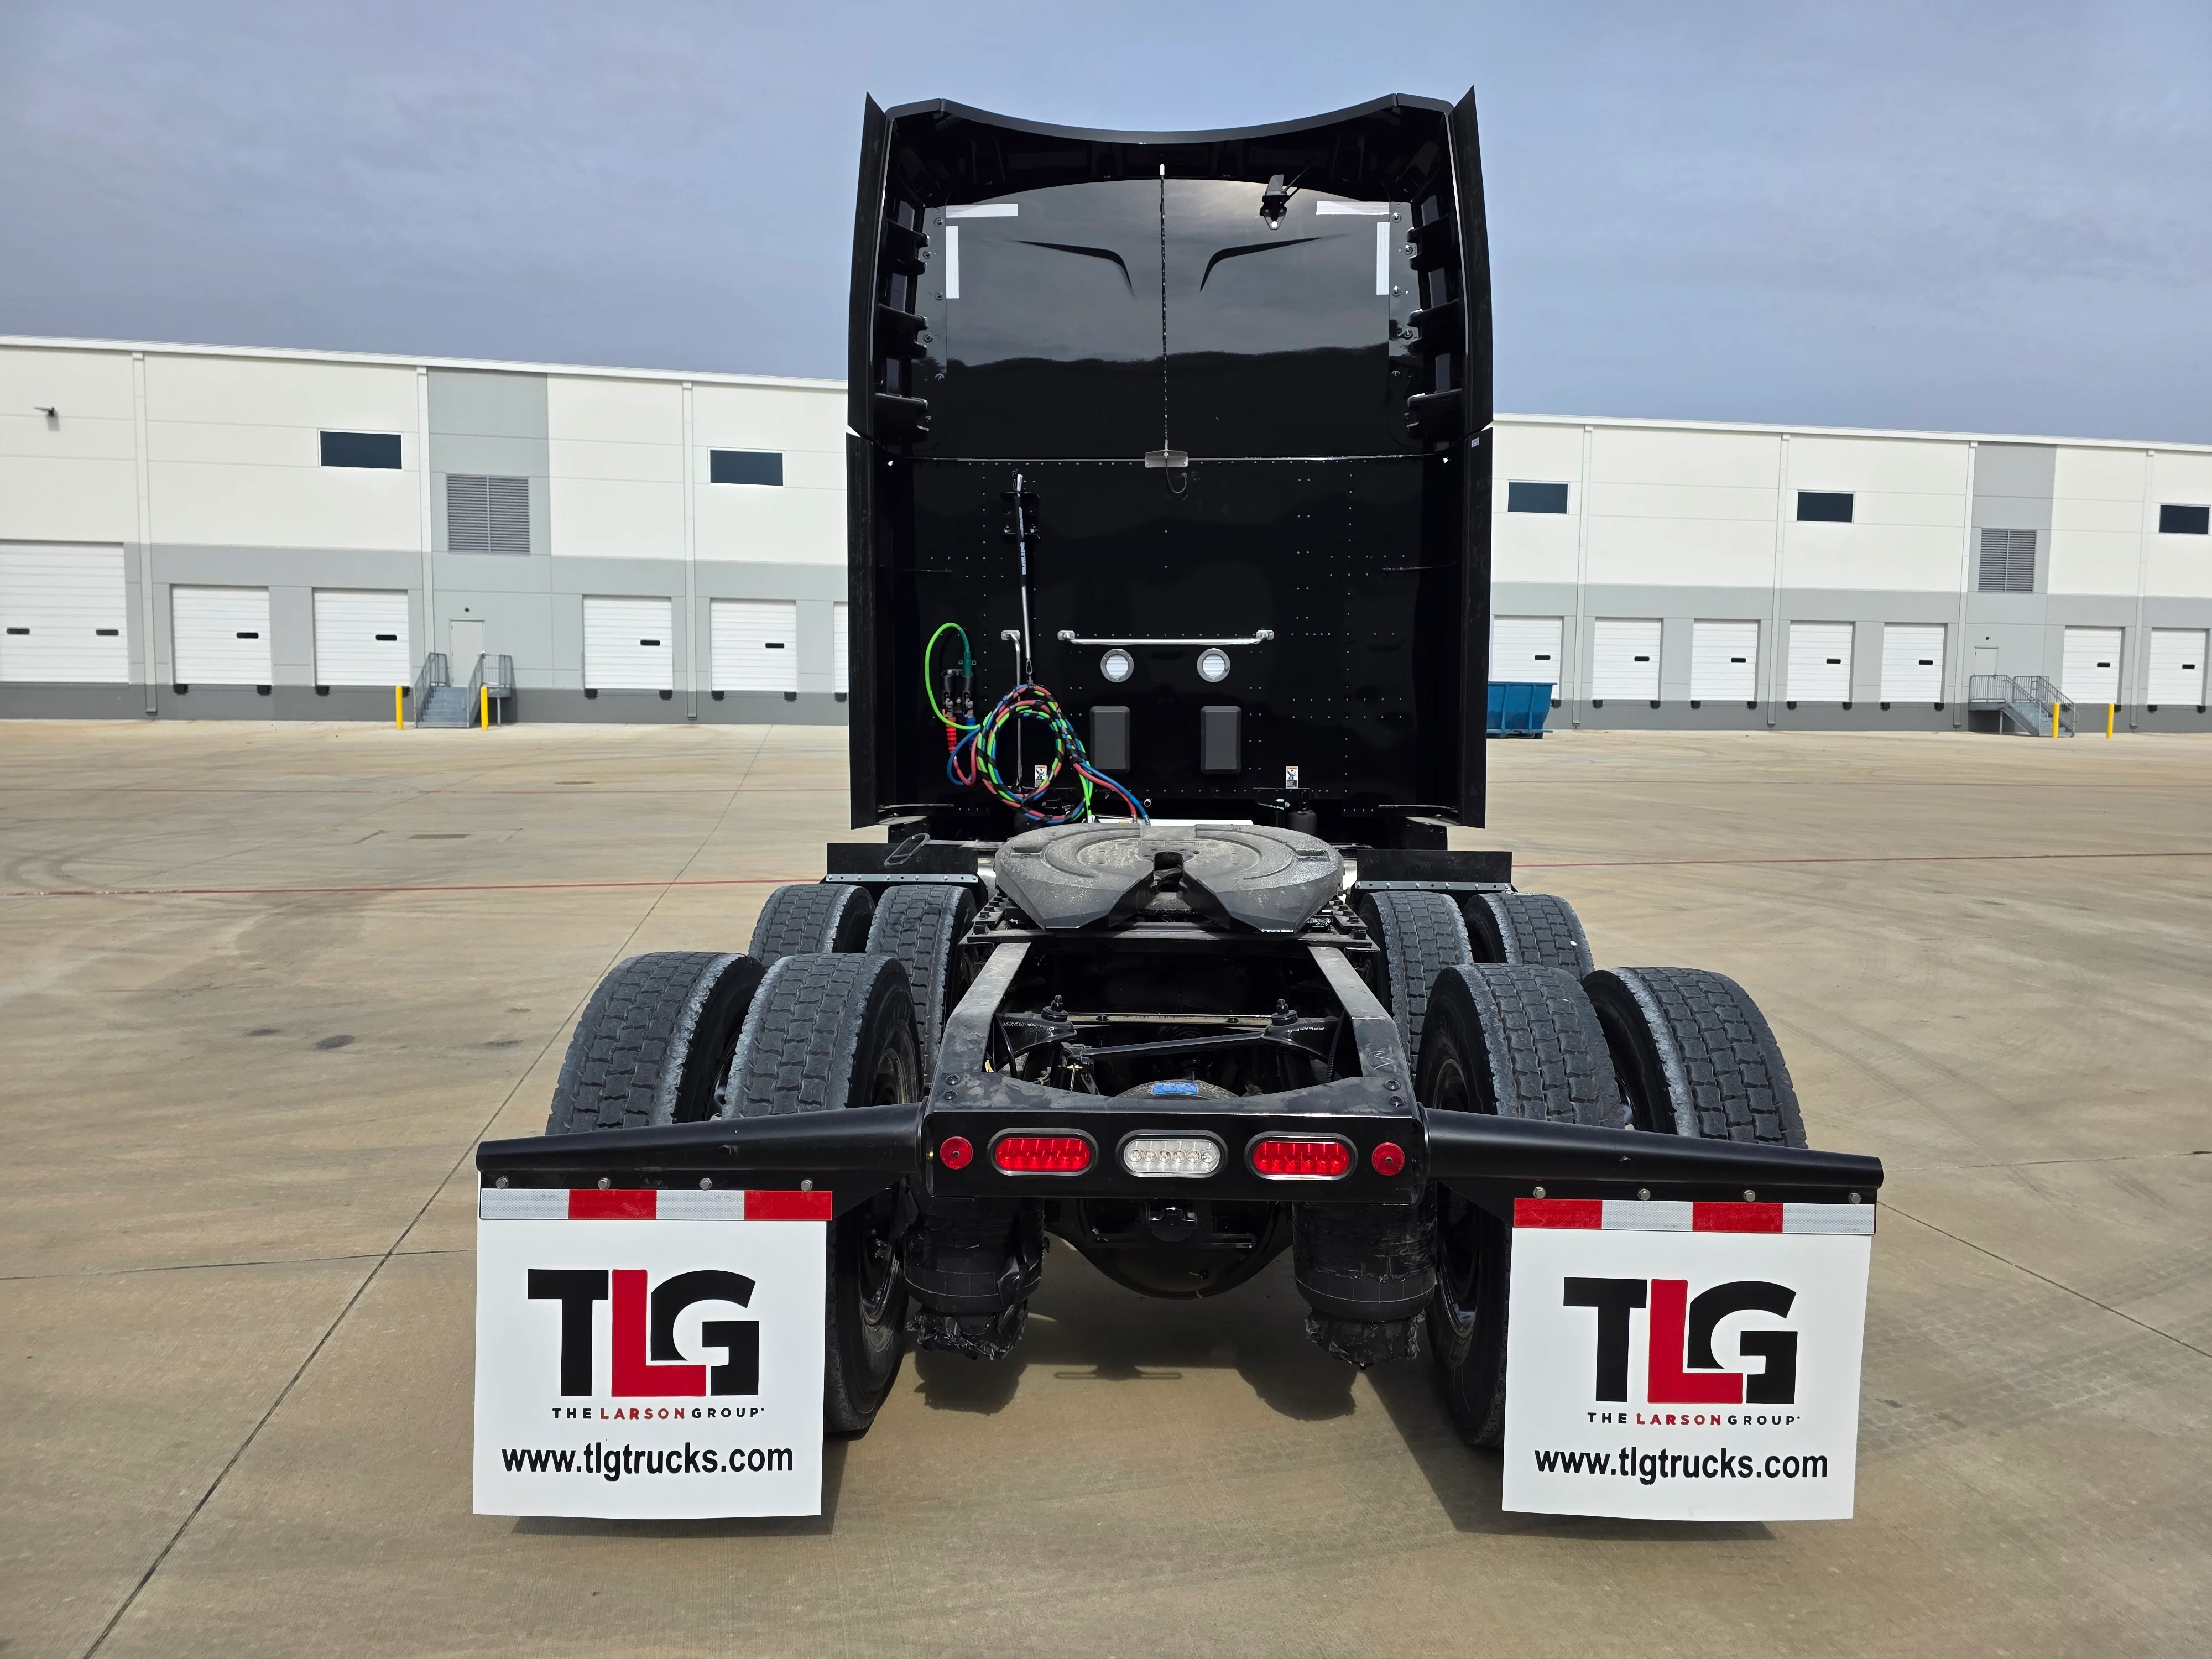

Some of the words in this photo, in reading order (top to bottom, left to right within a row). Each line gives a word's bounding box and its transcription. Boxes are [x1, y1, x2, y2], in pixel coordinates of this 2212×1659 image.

[527, 1269, 760, 1398] TLG
[1563, 1276, 1798, 1405] TLG
[552, 1408, 592, 1419] THE
[600, 1407, 685, 1420] LARSON
[1587, 1412, 1627, 1424] THE
[1636, 1413, 1721, 1426] LARSON
[501, 1442, 793, 1482] www.tlgtrucks.com
[1534, 1446, 1828, 1485] www.tlgtrucks.com
